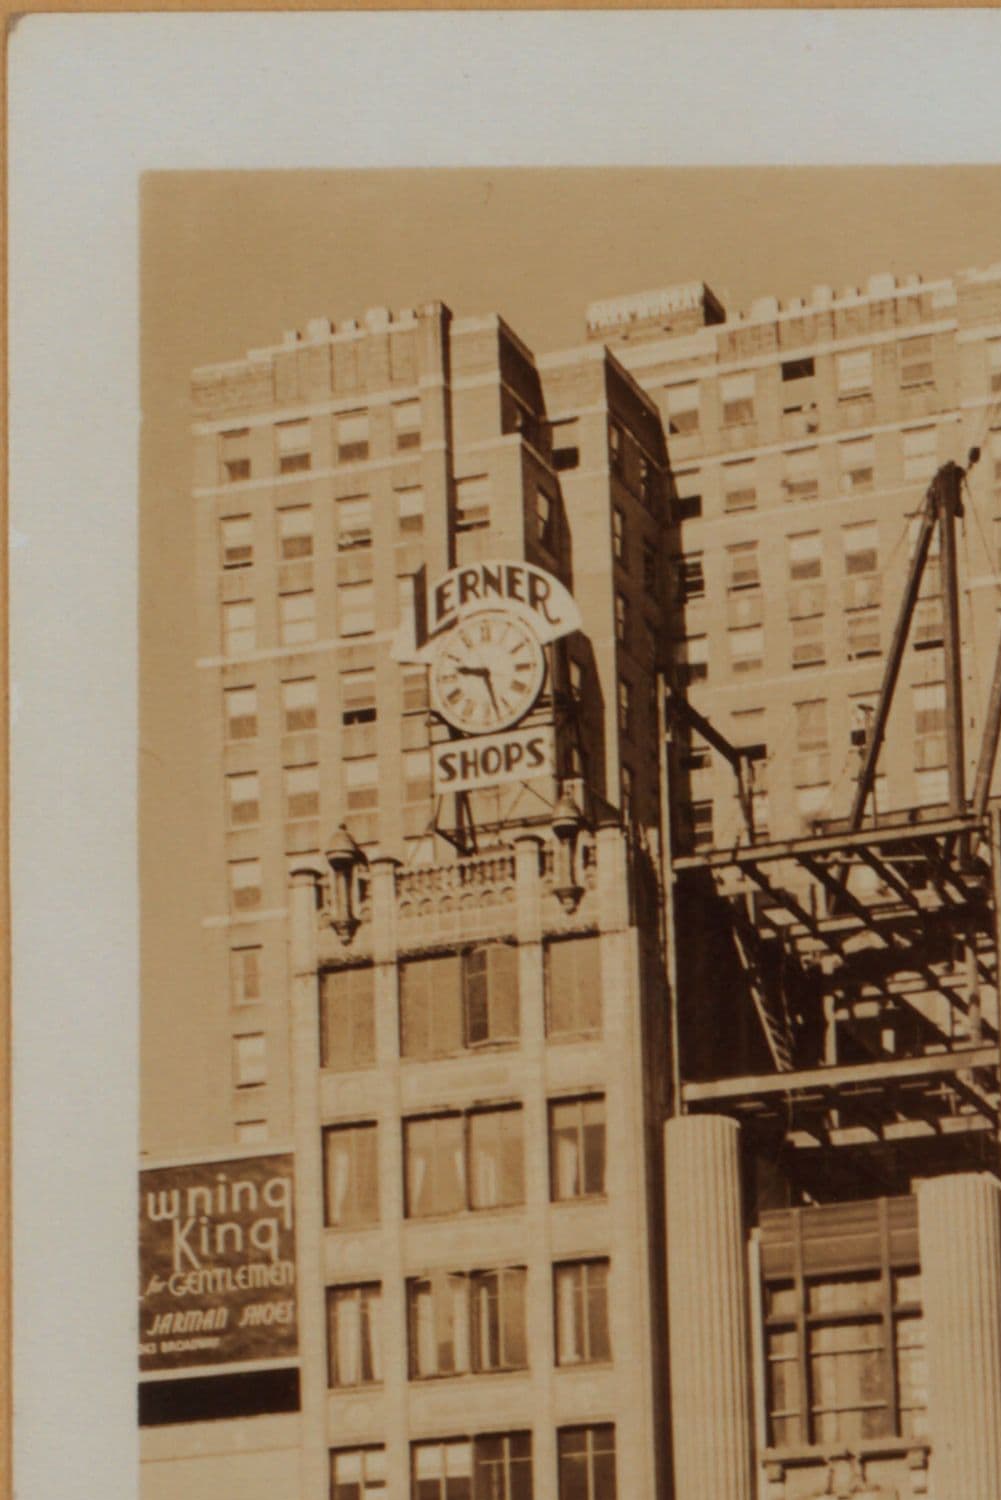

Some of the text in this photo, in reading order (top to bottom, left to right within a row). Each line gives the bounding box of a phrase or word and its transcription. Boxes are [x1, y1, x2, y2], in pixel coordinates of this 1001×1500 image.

[412, 562, 561, 651] LERNER
[437, 736, 545, 783] SHOPS
[172, 1216, 279, 1273] King
[167, 1260, 294, 1297] GENTLEMEN
[146, 1306, 229, 1336] JARMAN
